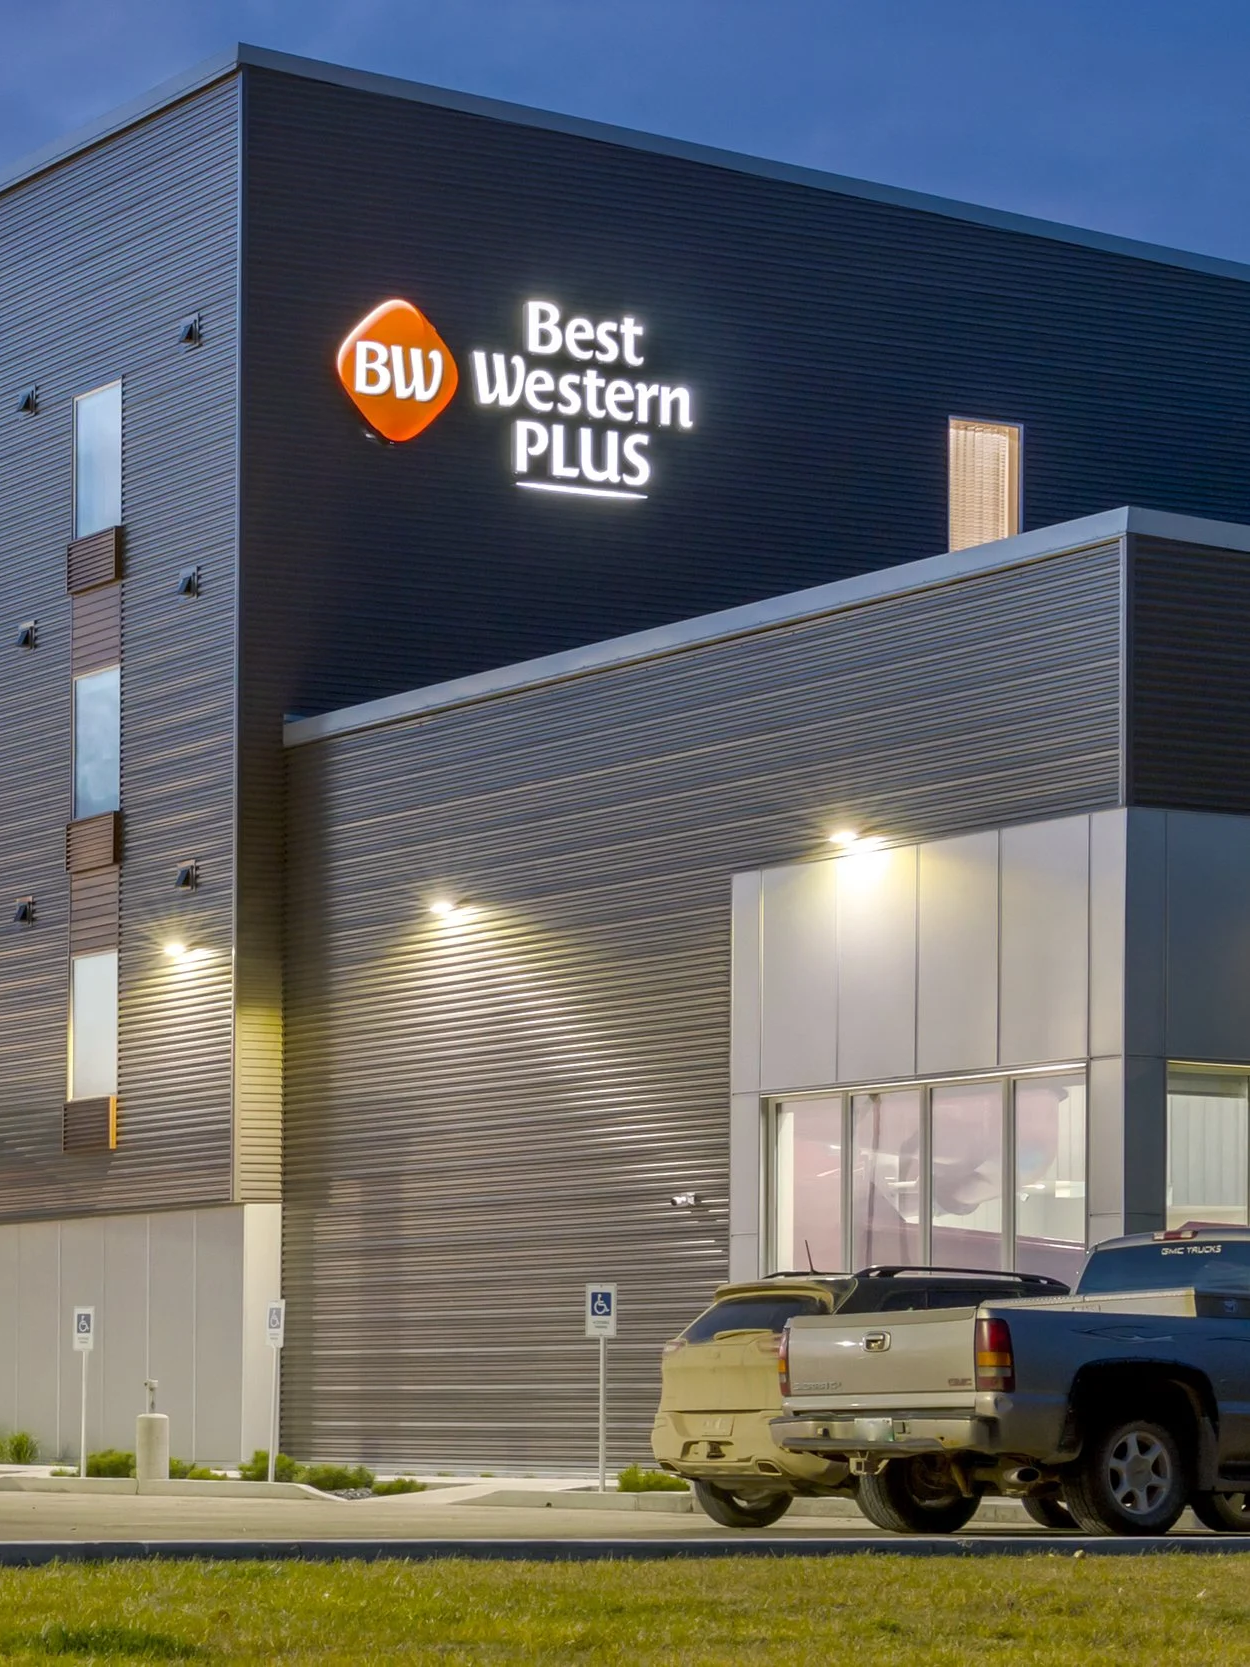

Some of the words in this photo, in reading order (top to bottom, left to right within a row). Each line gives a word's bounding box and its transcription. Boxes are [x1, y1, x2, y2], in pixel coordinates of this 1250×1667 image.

[526, 300, 645, 367] Best
[354, 340, 444, 402] BW
[472, 350, 694, 429] Western
[514, 419, 651, 487] PLUS
[1161, 1247, 1185, 1256] GMC
[1186, 1245, 1222, 1254] TRUCKS
